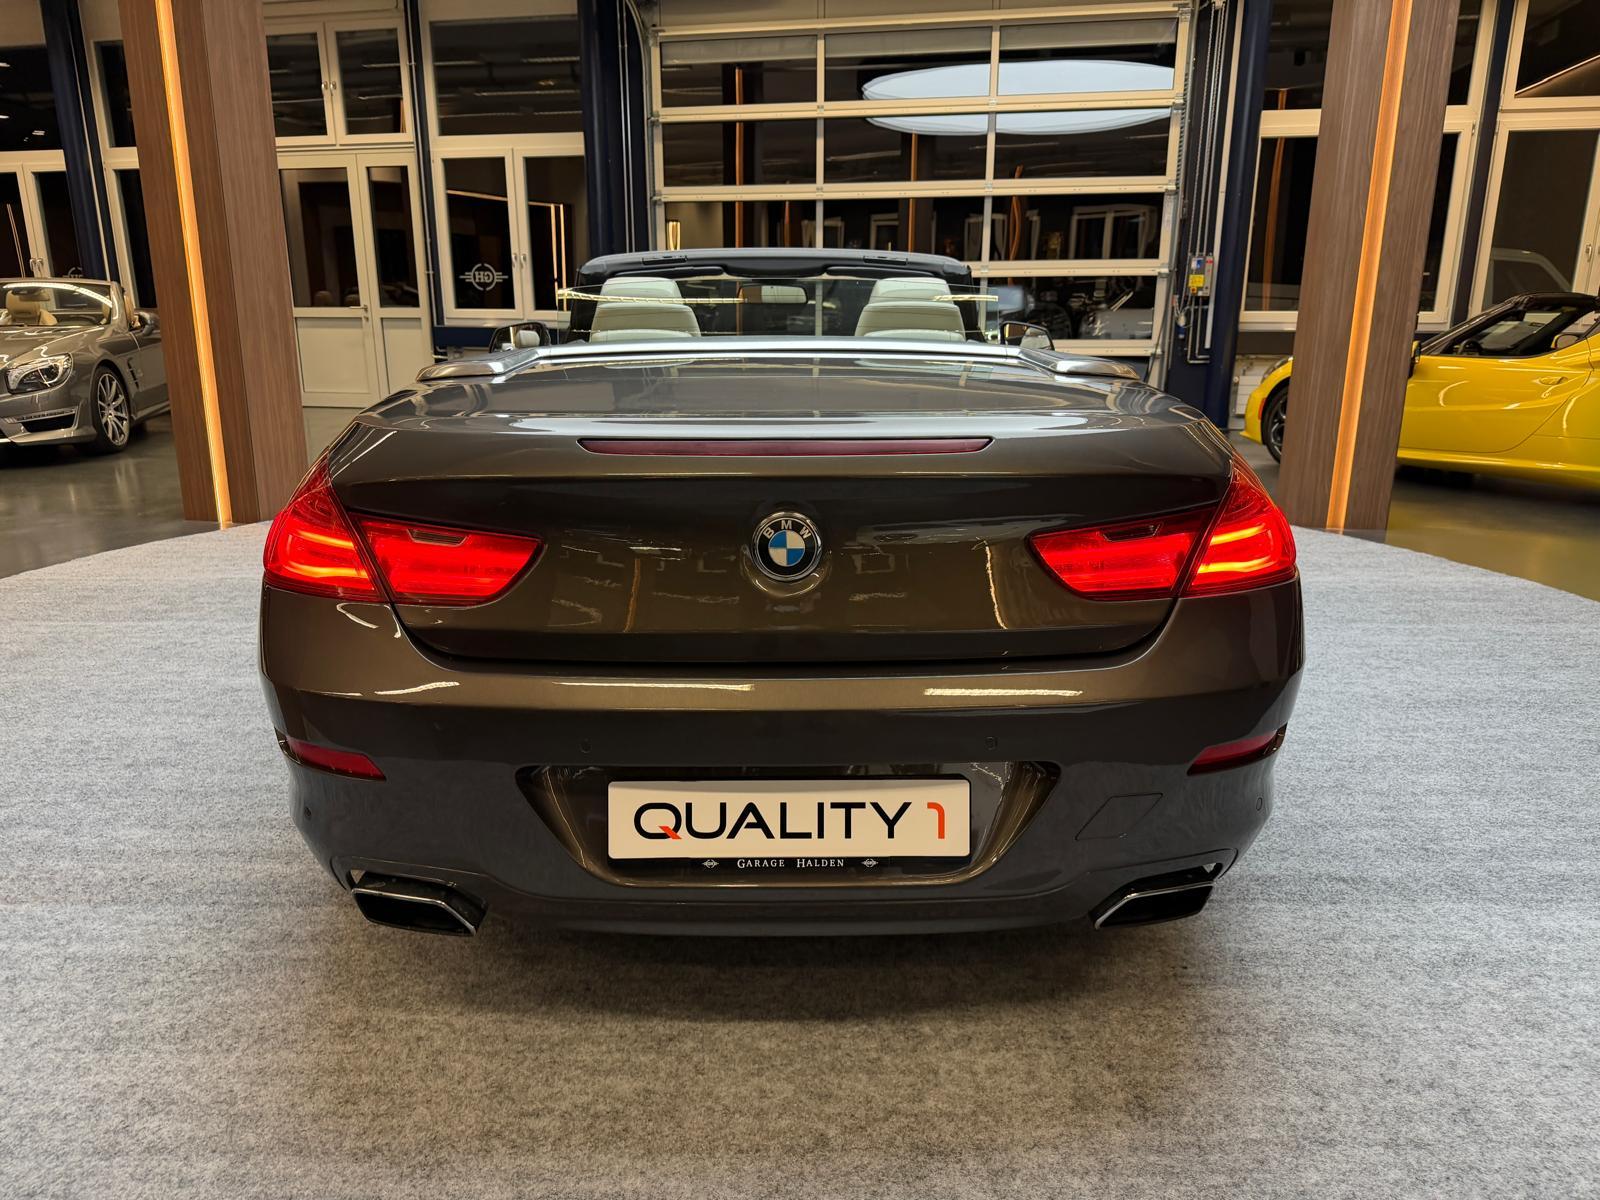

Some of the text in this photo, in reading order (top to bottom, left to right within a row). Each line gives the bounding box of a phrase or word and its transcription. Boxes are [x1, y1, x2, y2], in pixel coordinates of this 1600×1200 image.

[763, 520, 811, 539] BMW
[634, 802, 945, 839] QUALITY 1
[737, 859, 844, 868] GARAGE HALDEN
